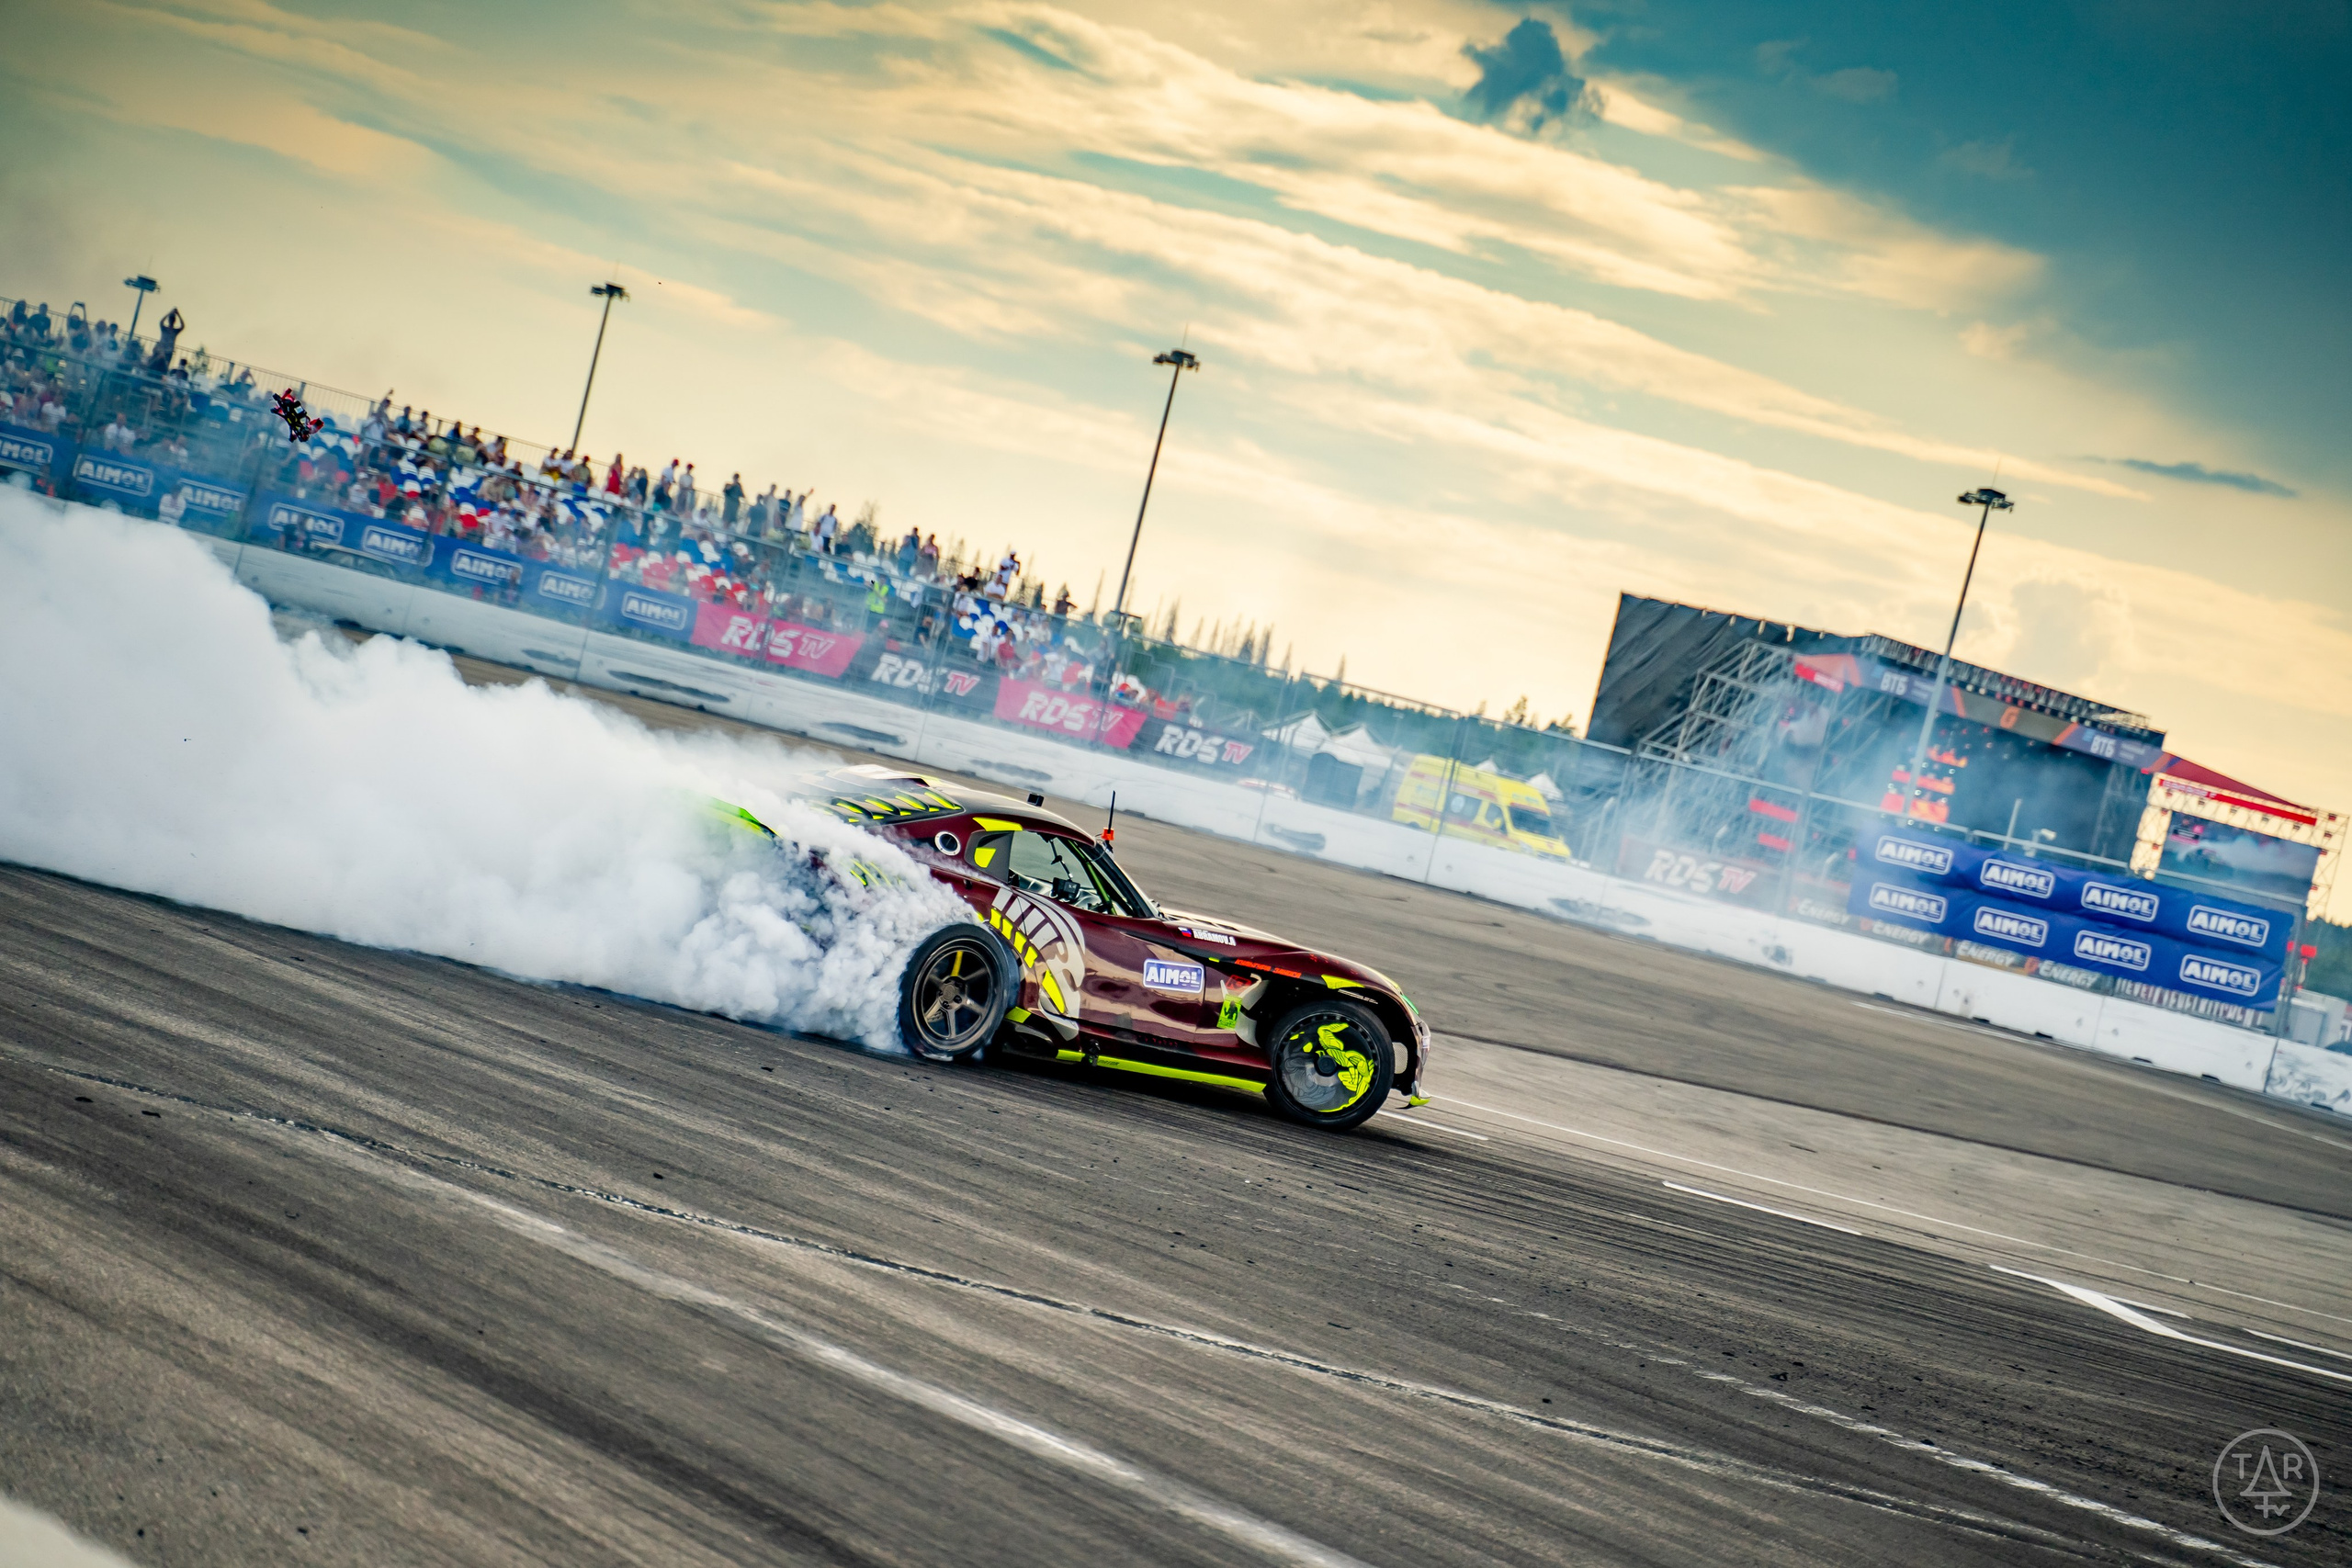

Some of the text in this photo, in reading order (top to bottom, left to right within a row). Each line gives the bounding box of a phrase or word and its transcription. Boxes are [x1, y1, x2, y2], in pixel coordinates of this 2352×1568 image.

[79, 460, 147, 490] AIMOL
[720, 615, 836, 660] RDS TV
[944, 670, 980, 697] TV
[1019, 691, 1093, 731] RDS
[1154, 724, 1254, 765] RDS TV
[1879, 841, 1947, 868] AIMOL
[1643, 849, 1758, 894] RDS TV
[1984, 864, 2050, 892] AIMOL
[1872, 888, 1941, 916] AIMOL
[2085, 887, 2154, 916] AIMOL
[1977, 912, 2042, 941] AIMOL
[2190, 911, 2263, 941] AIMOL
[2077, 936, 2145, 964] AIMOL
[1146, 966, 1201, 988] AIMOL
[2184, 961, 2255, 989] AIMOL
